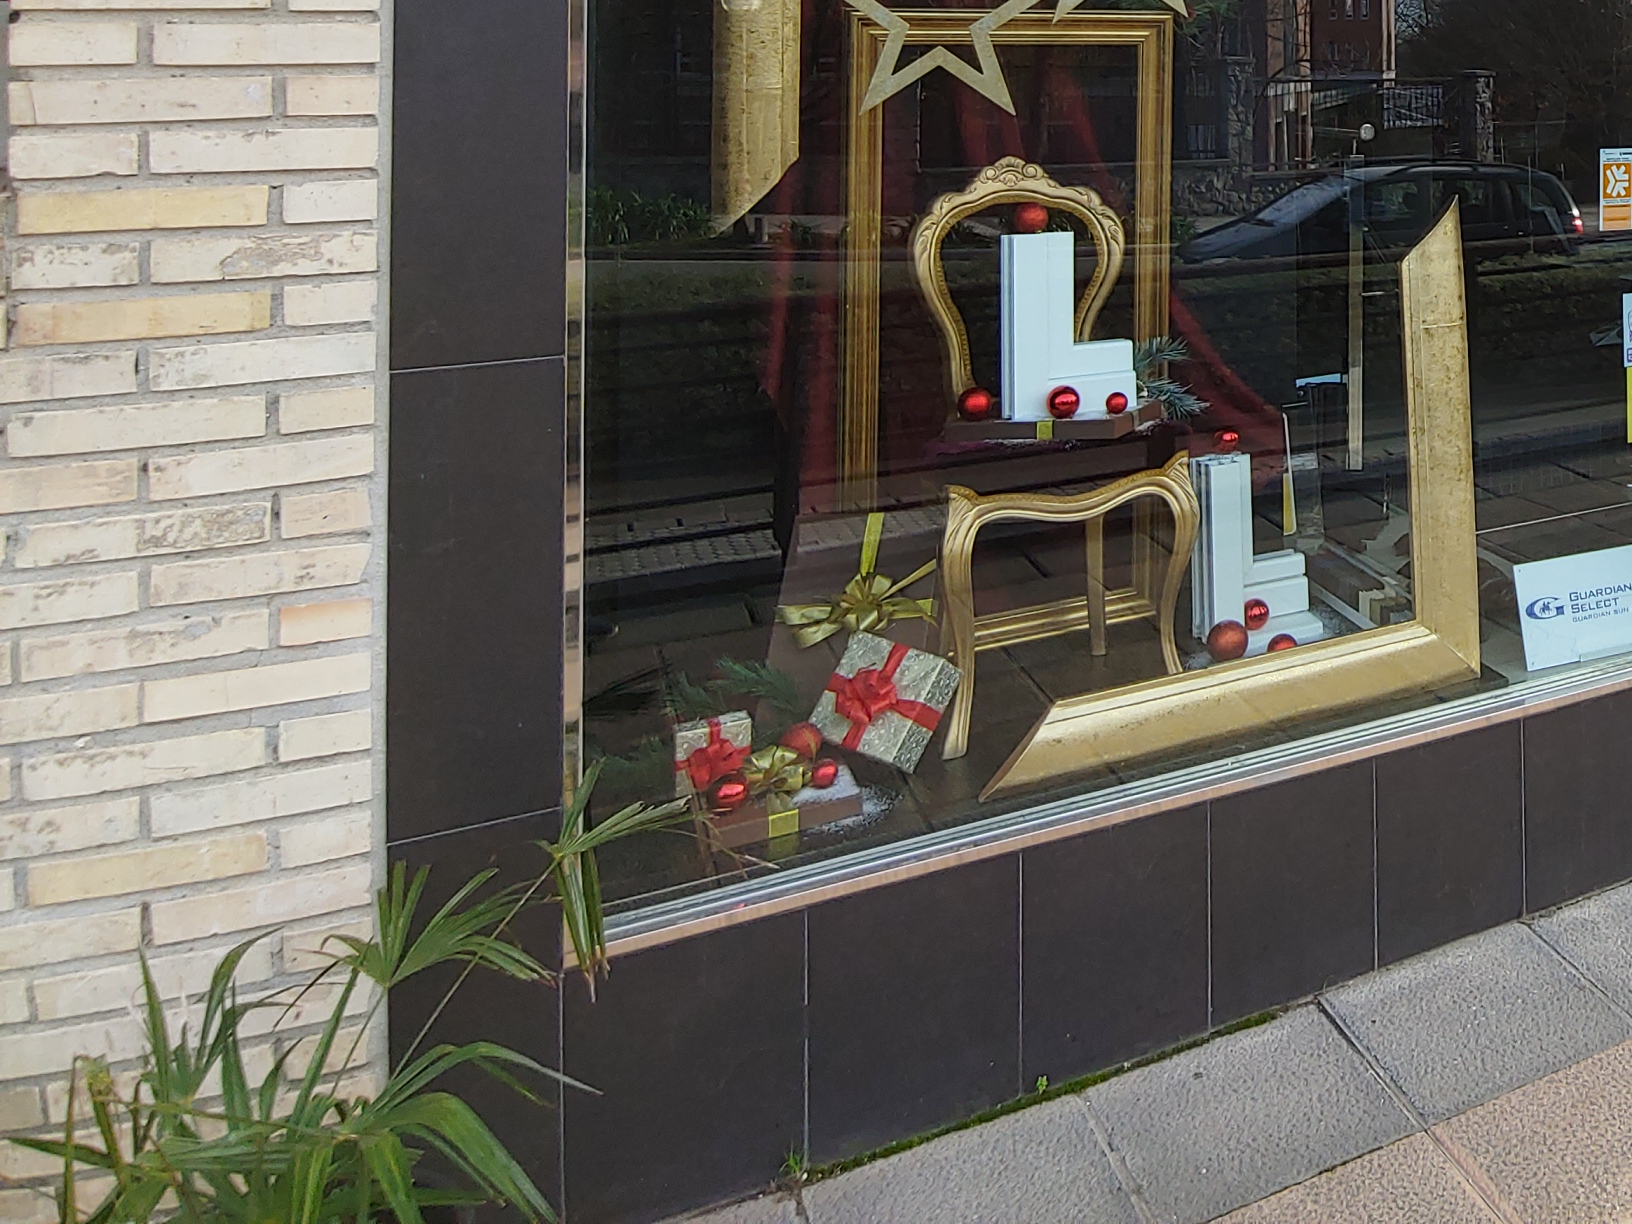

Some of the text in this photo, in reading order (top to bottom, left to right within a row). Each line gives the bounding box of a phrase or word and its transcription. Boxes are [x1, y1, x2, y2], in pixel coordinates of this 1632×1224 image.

[1569, 583, 1632, 602] GUARDIAN
[1571, 597, 1619, 614] SELECT
[1572, 611, 1611, 623] GUARDIAN
[1613, 607, 1629, 615] SUN
